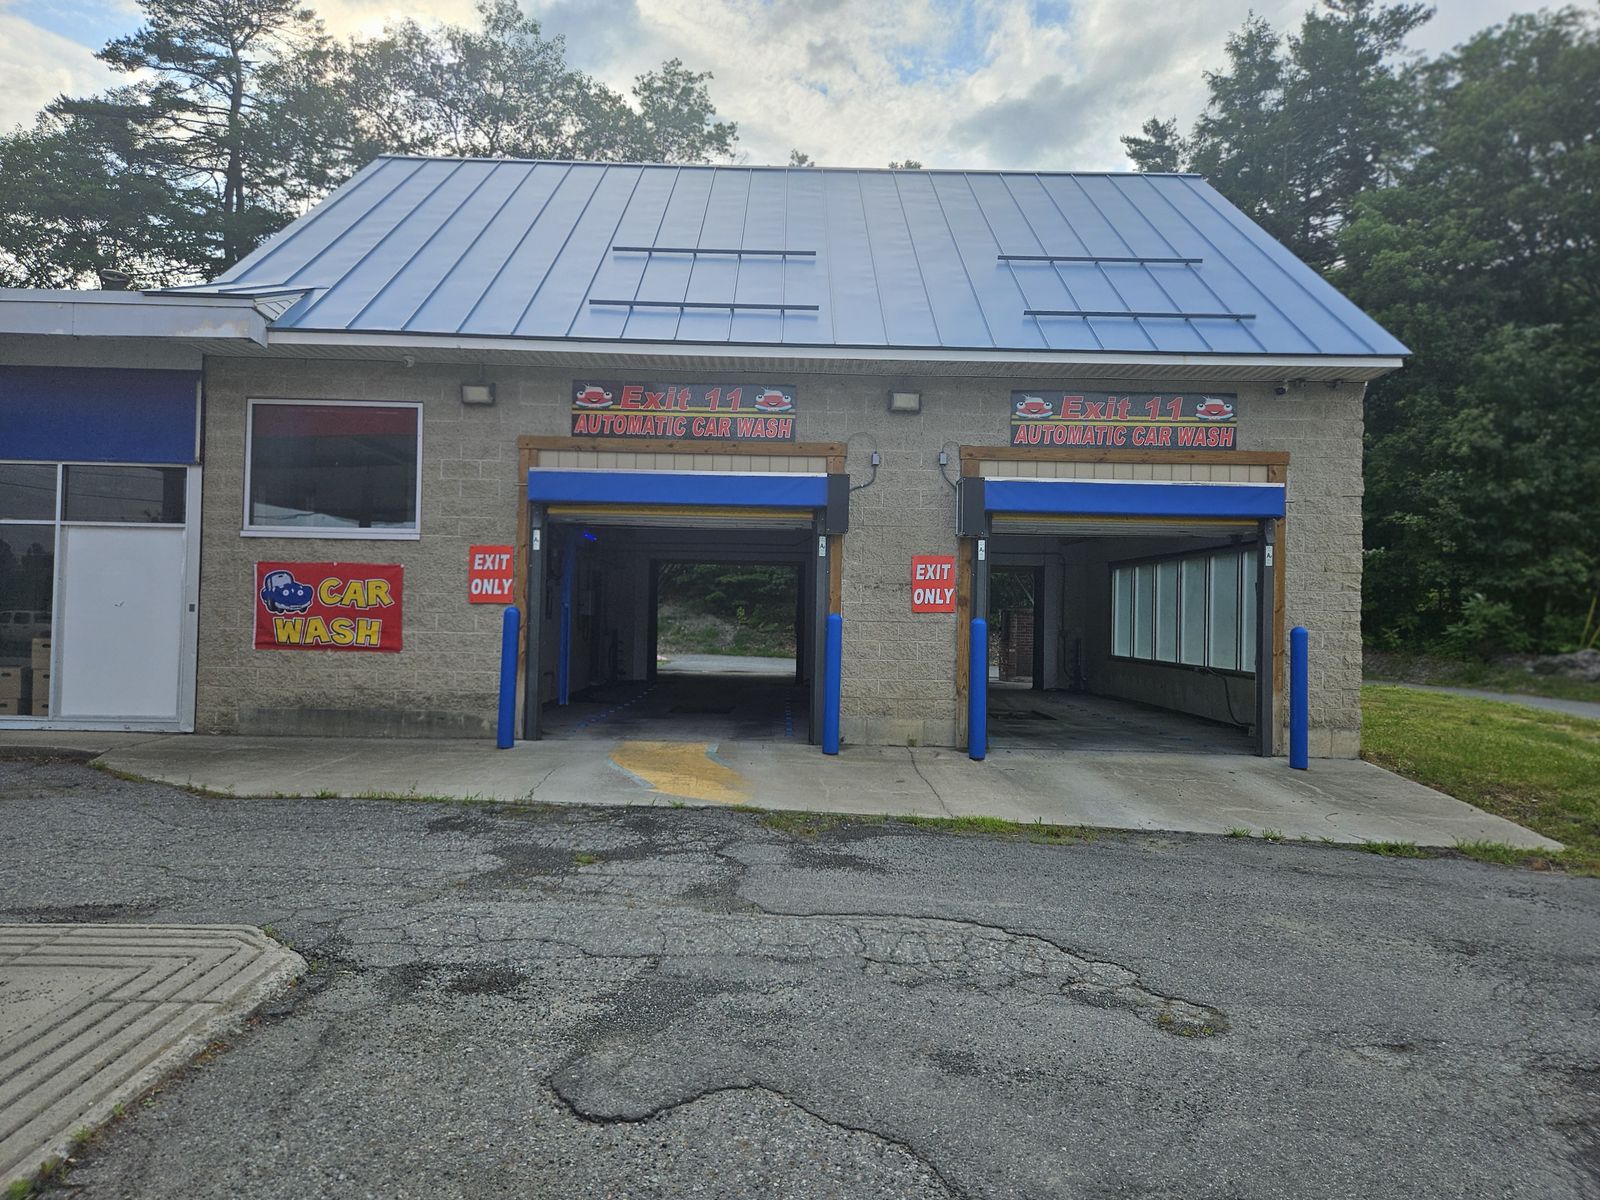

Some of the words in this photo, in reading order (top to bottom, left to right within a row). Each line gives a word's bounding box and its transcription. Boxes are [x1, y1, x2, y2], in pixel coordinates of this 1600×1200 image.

[620, 385, 691, 411] Exit
[704, 387, 743, 412] 11
[1060, 395, 1131, 420] Exit
[1144, 396, 1184, 421] 11
[574, 414, 686, 437] AUTOMATIC
[692, 416, 732, 437] CAR
[737, 417, 793, 439] WASH
[1014, 424, 1126, 446] AUTOMATIC
[1132, 425, 1172, 446] CAR
[1177, 426, 1234, 447] WASH
[474, 553, 510, 570] EXIT
[915, 563, 951, 580] EXIT
[317, 577, 395, 610] CAR
[471, 578, 513, 595] ONLY
[913, 588, 955, 605] ONLY
[273, 616, 382, 647] WASH
